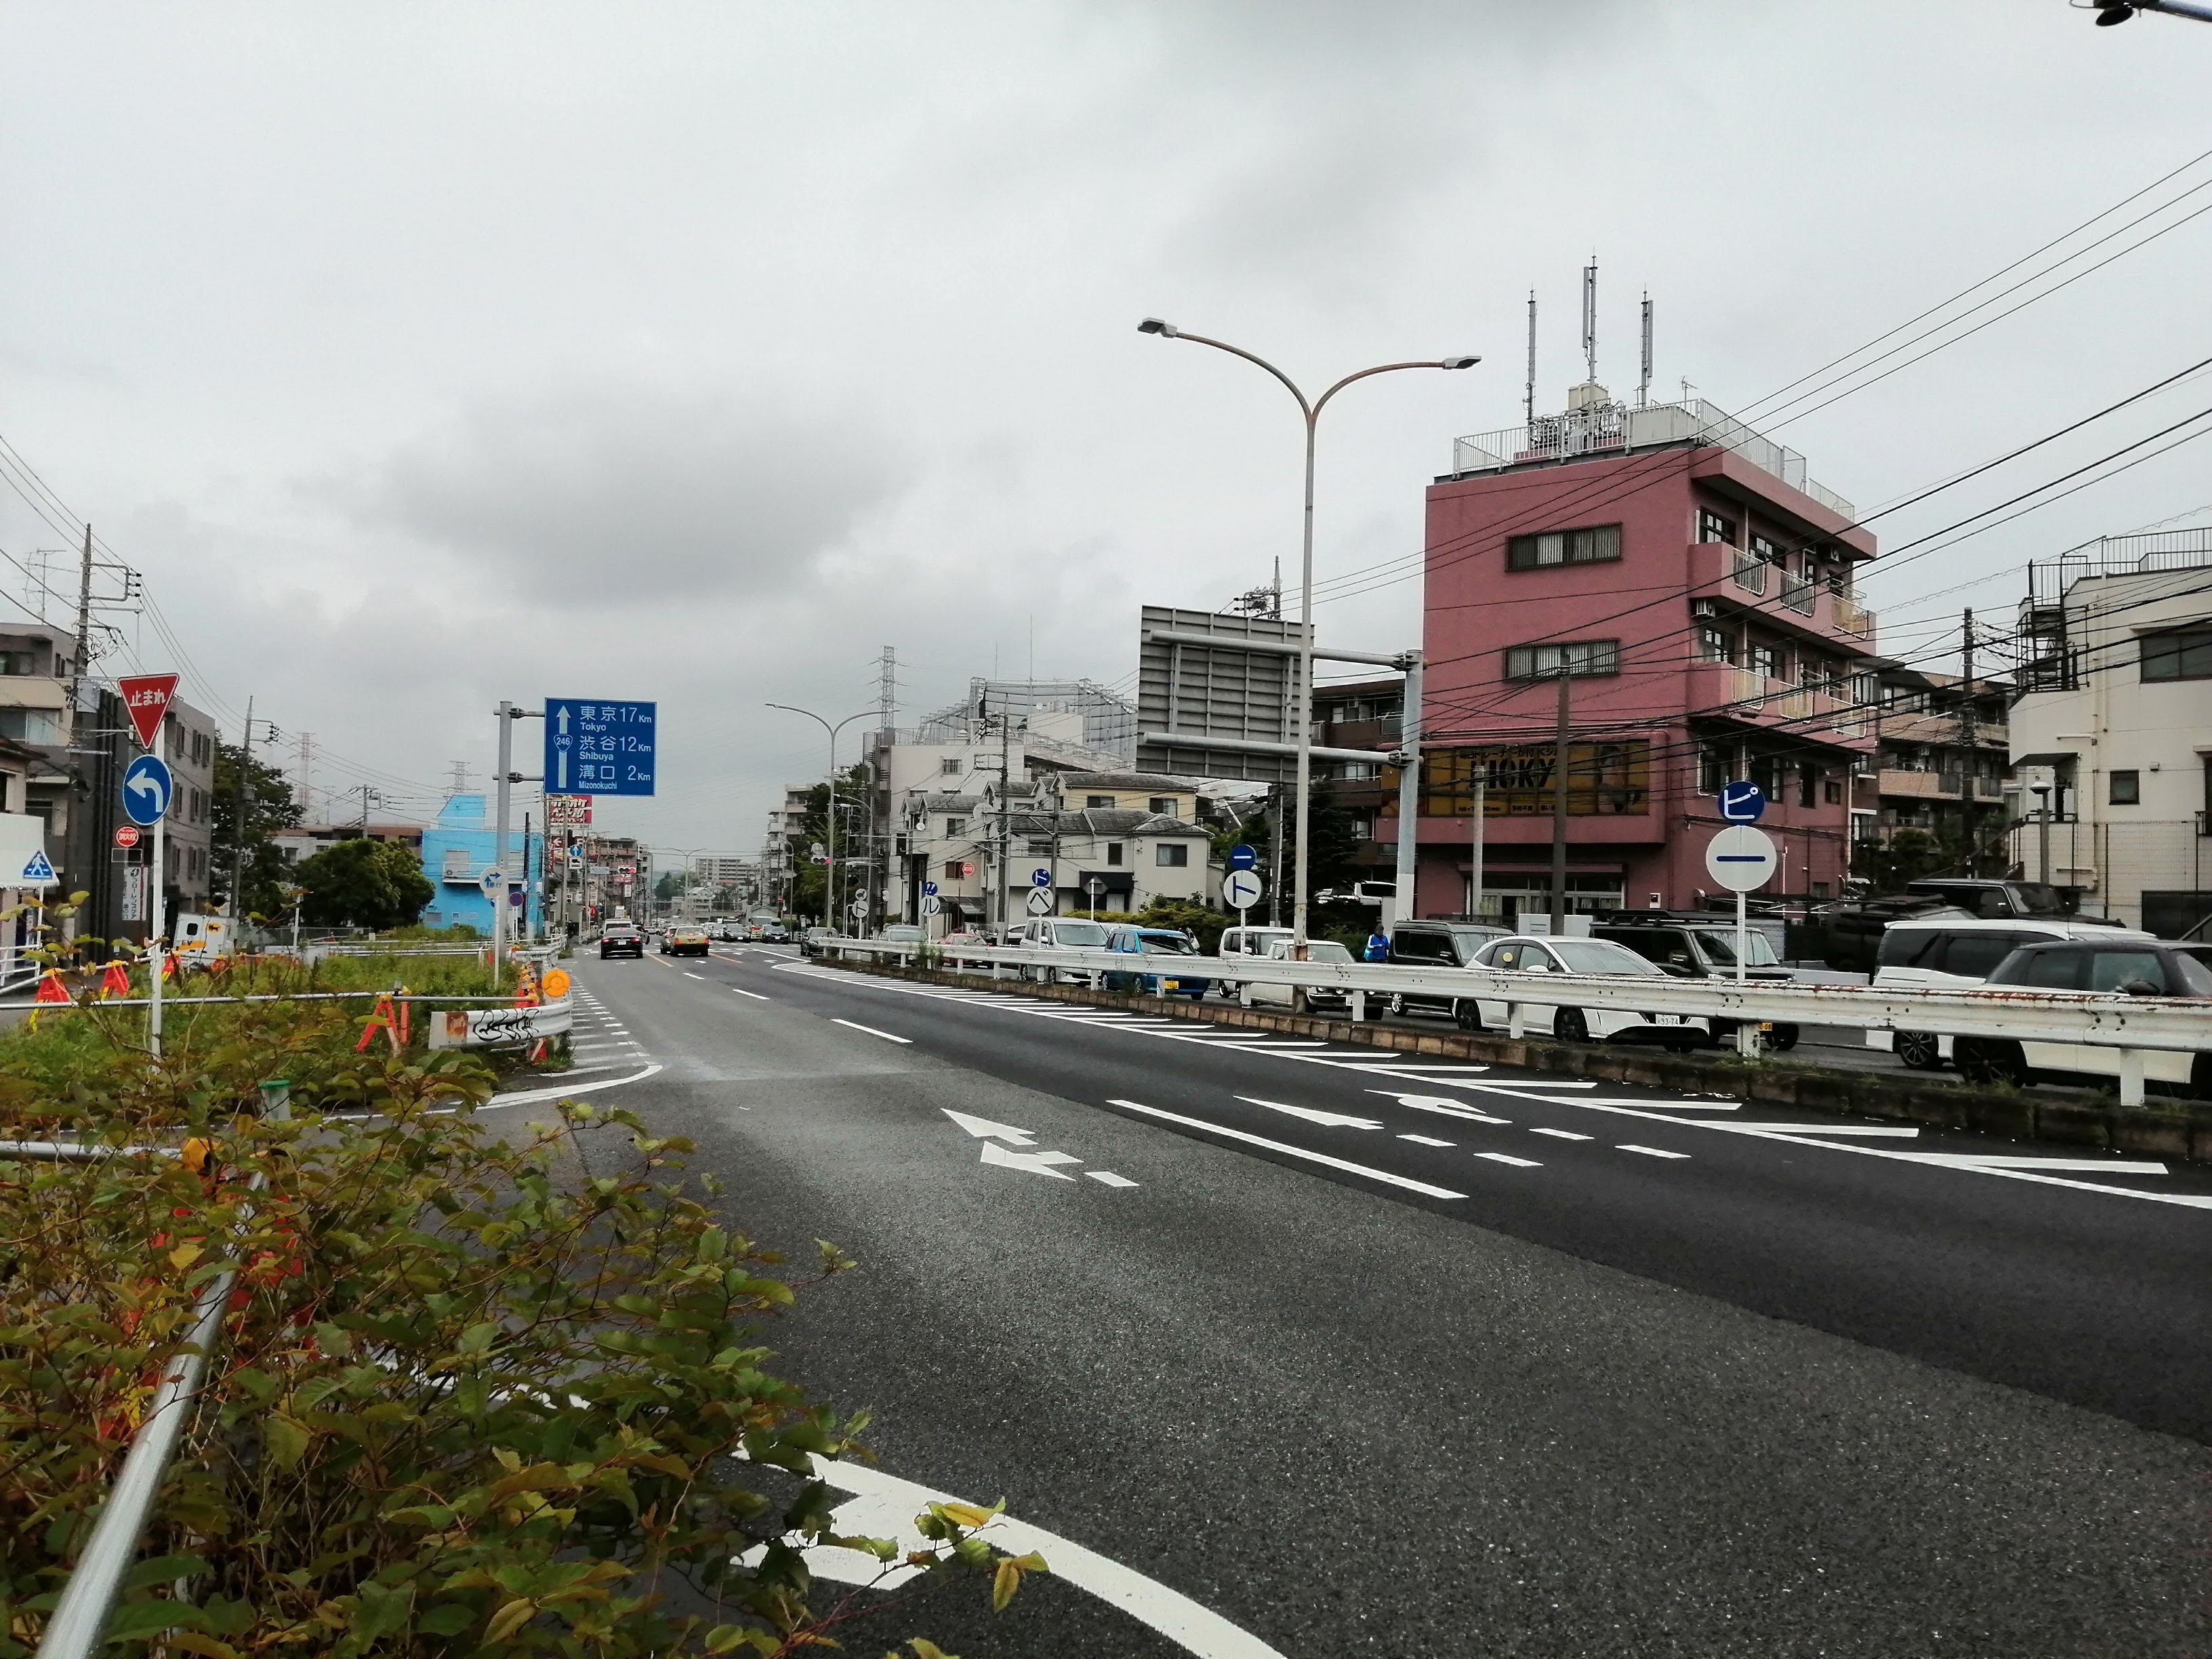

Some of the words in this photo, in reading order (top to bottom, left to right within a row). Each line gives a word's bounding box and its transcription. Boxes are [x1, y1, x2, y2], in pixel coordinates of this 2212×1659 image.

[129, 689, 166, 707] 止まれ
[580, 705, 617, 722] 東京
[580, 722, 607, 732] Tokyo
[556, 737, 571, 745] 246
[579, 735, 616, 750] 渋谷
[579, 752, 614, 762] Shibuya
[579, 764, 615, 779] 溝口
[579, 781, 617, 790] Mizonokuchi
[1723, 786, 1759, 820] ピ
[1233, 875, 1256, 904] ト
[923, 898, 939, 914] ル
[1029, 889, 1050, 909] ベ
[856, 902, 867, 916] ト
